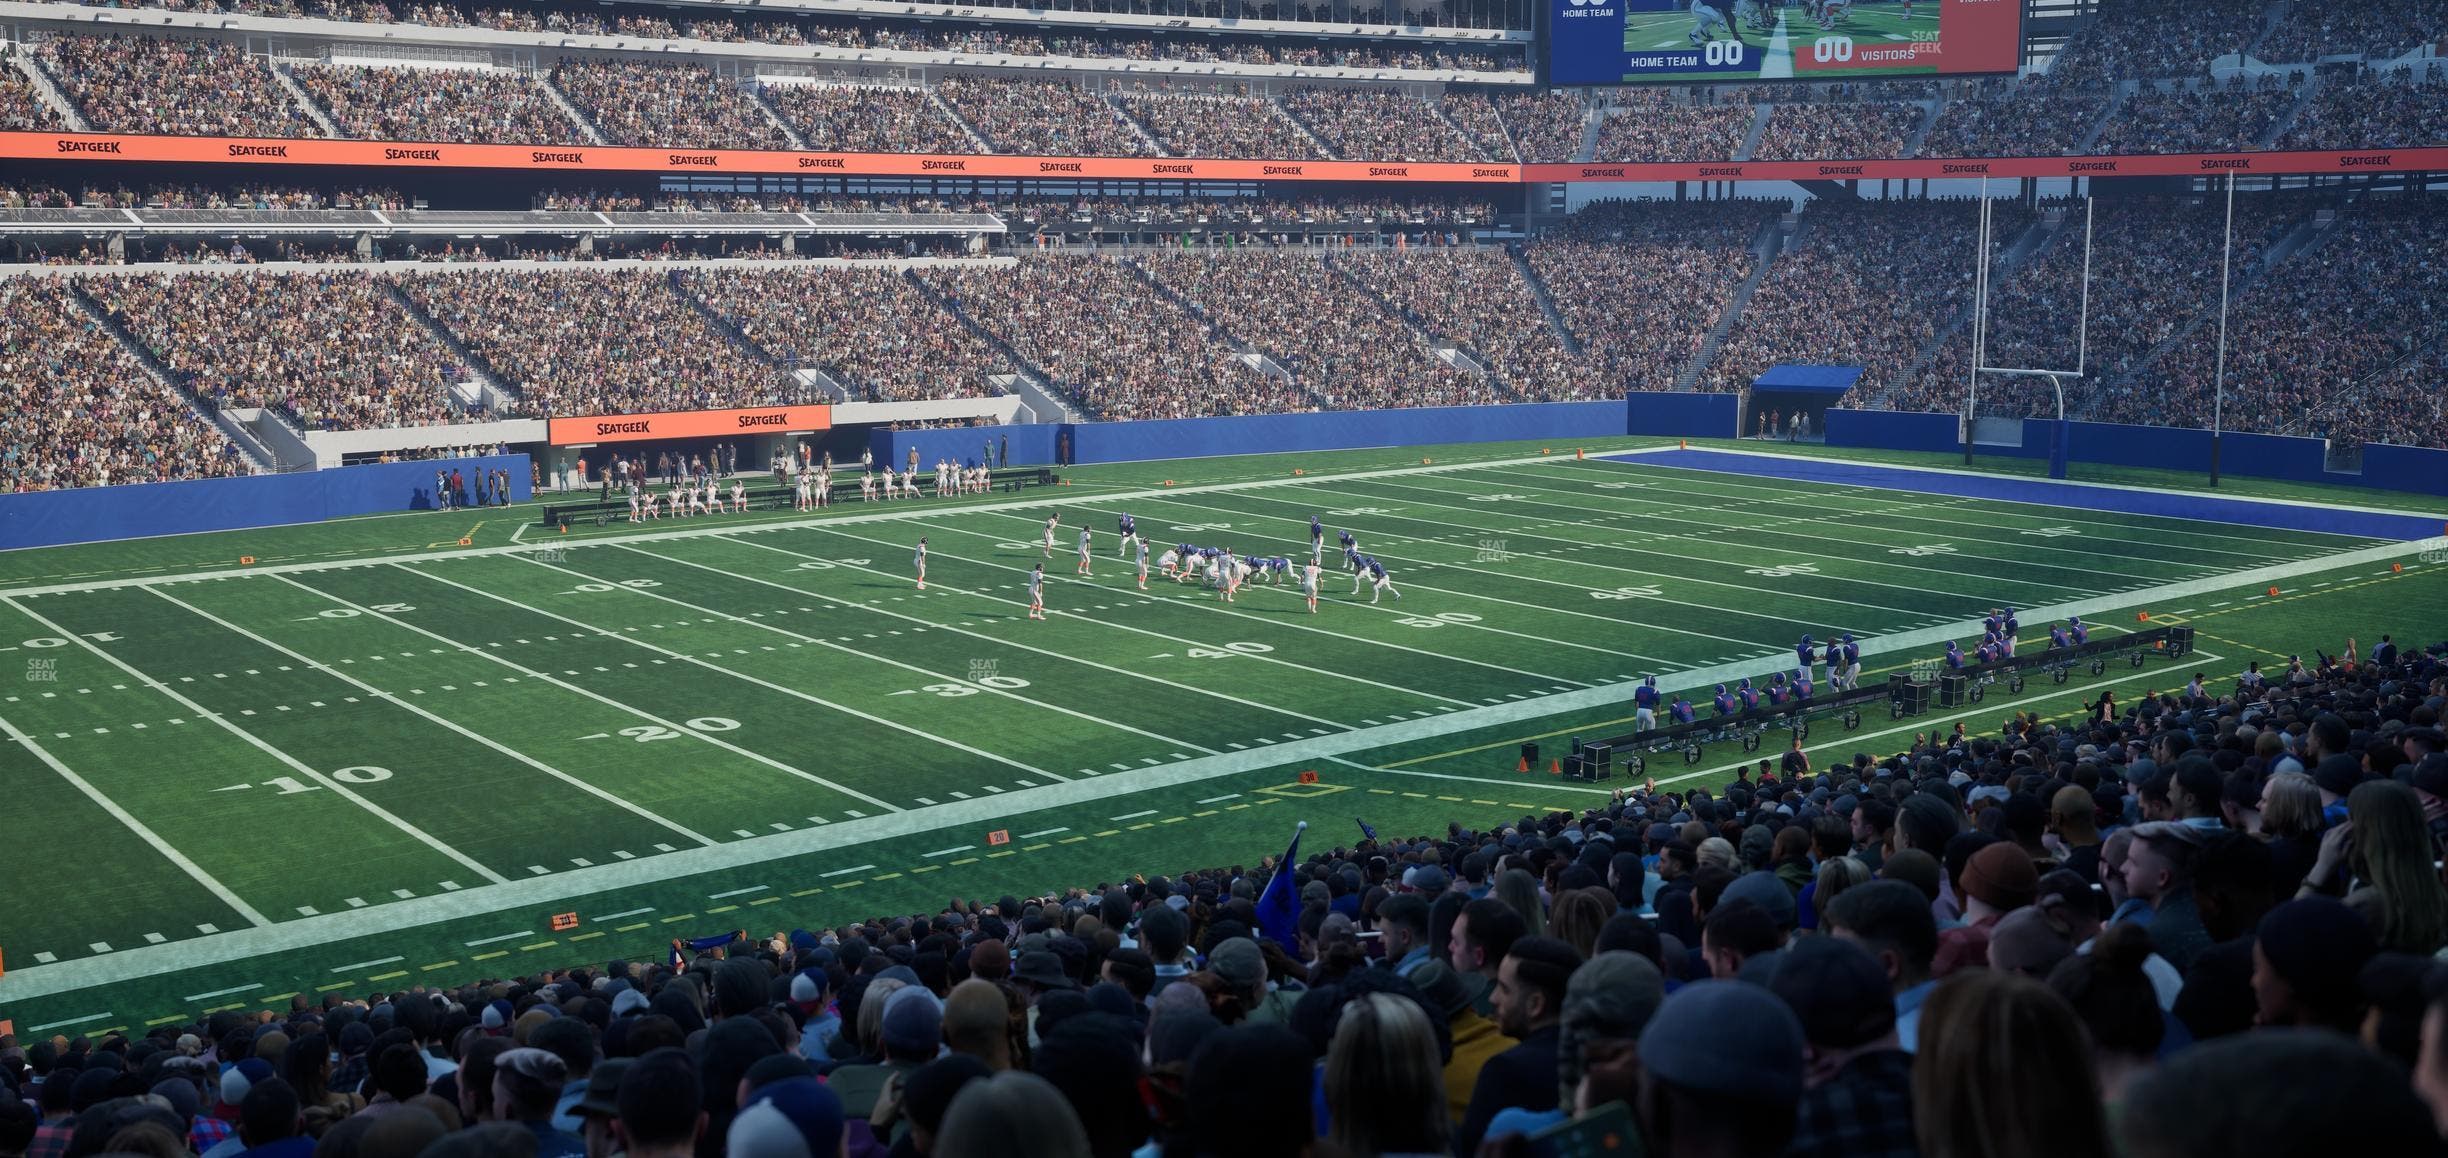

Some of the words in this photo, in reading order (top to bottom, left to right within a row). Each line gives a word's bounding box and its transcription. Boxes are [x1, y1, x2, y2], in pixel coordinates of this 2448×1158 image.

[1562, 9, 1588, 18] HOME
[1589, 8, 1614, 17] TEAM
[1705, 40, 1743, 66] 00
[1814, 36, 1853, 62] 00
[1860, 49, 1915, 62] VISITORS
[1631, 57, 1664, 68] HOME
[1666, 56, 1698, 67] TEAM
[58, 140, 121, 153] SEATGEEK
[229, 144, 287, 157] SEATGEEK
[385, 149, 440, 160] SEATGEEK
[532, 152, 583, 163] SEATGEEK
[670, 155, 717, 166] SEATGEEK
[799, 158, 845, 168] SEATGEEK
[922, 160, 965, 170] SEATGEEK
[2201, 158, 2251, 170] SEATGEEK
[2340, 154, 2392, 167] SEATGEEK
[1040, 162, 1081, 172] SEATGEEK
[1153, 164, 1193, 174] SEATGEEK
[1264, 166, 1302, 175] SEATGEEK
[1369, 168, 1407, 176] SEATGEEK
[1699, 167, 1743, 176] SEATGEEK
[1819, 165, 1863, 174] SEATGEEK
[1943, 163, 1988, 173] SEATGEEK
[2069, 161, 2117, 172] SEATGEEK
[1473, 169, 1509, 178] SEATGEEK
[1582, 168, 1625, 177] SEATGEEK
[739, 413, 787, 427] SEATGEEK
[597, 421, 650, 436] SEATGEEK
[1393, 612, 1483, 628] 50
[1187, 642, 1275, 659] 40
[922, 676, 1031, 697] 30
[618, 717, 742, 743] 20
[260, 765, 394, 795] 10
[994, 832, 1004, 843] 20
